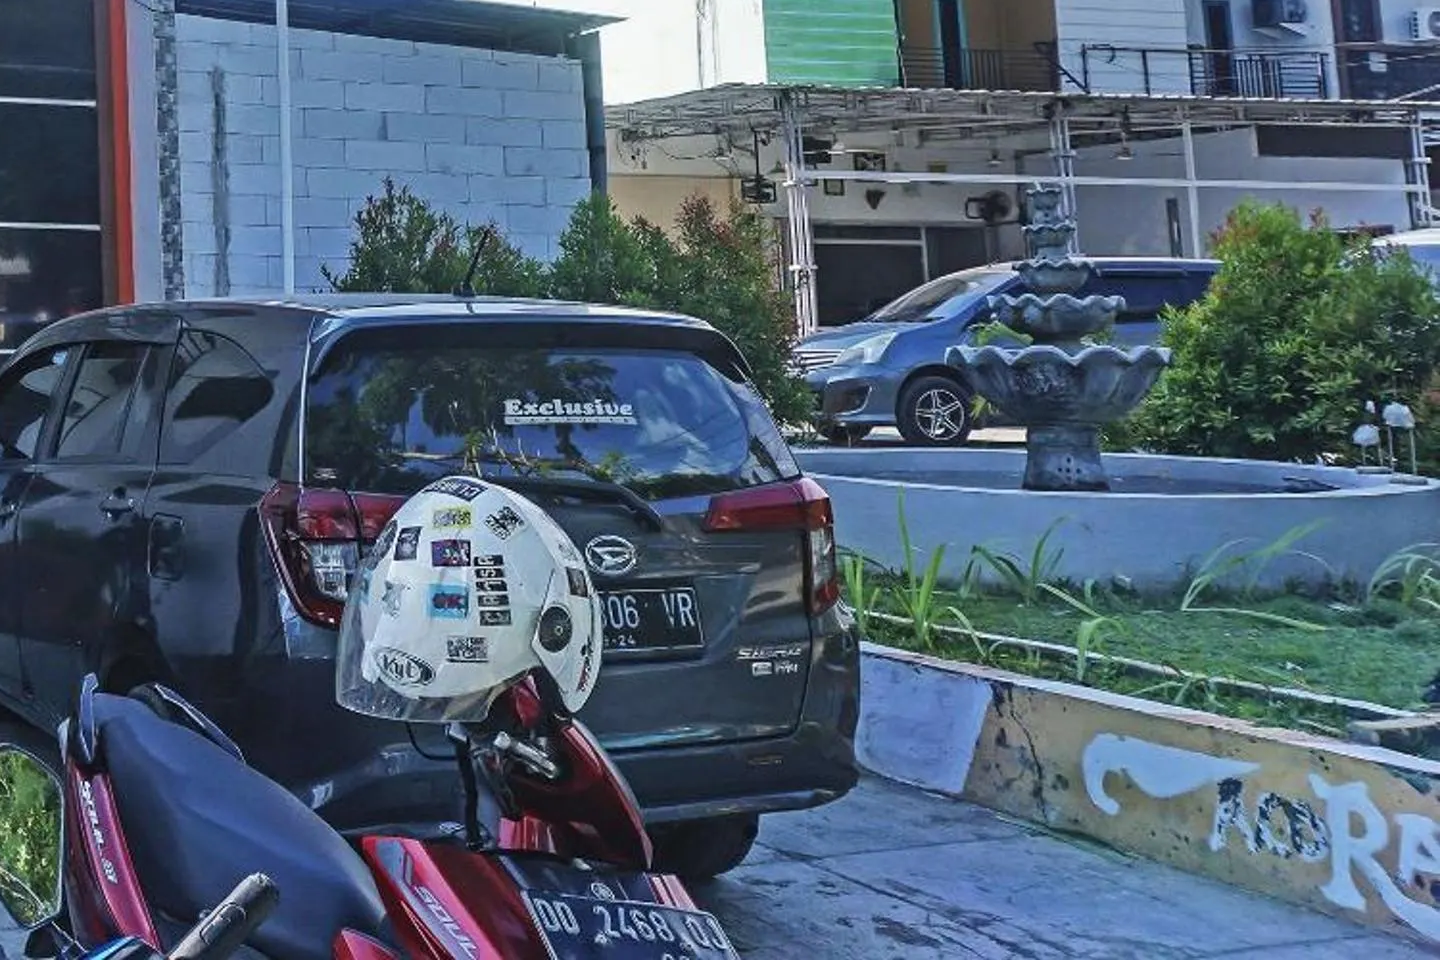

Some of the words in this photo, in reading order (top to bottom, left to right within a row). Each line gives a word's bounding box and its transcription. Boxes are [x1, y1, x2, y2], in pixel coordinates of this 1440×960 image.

[503, 398, 633, 416] Exclusive
[661, 592, 696, 628] VR
[532, 897, 580, 936] DD
[593, 904, 675, 944] 2468
